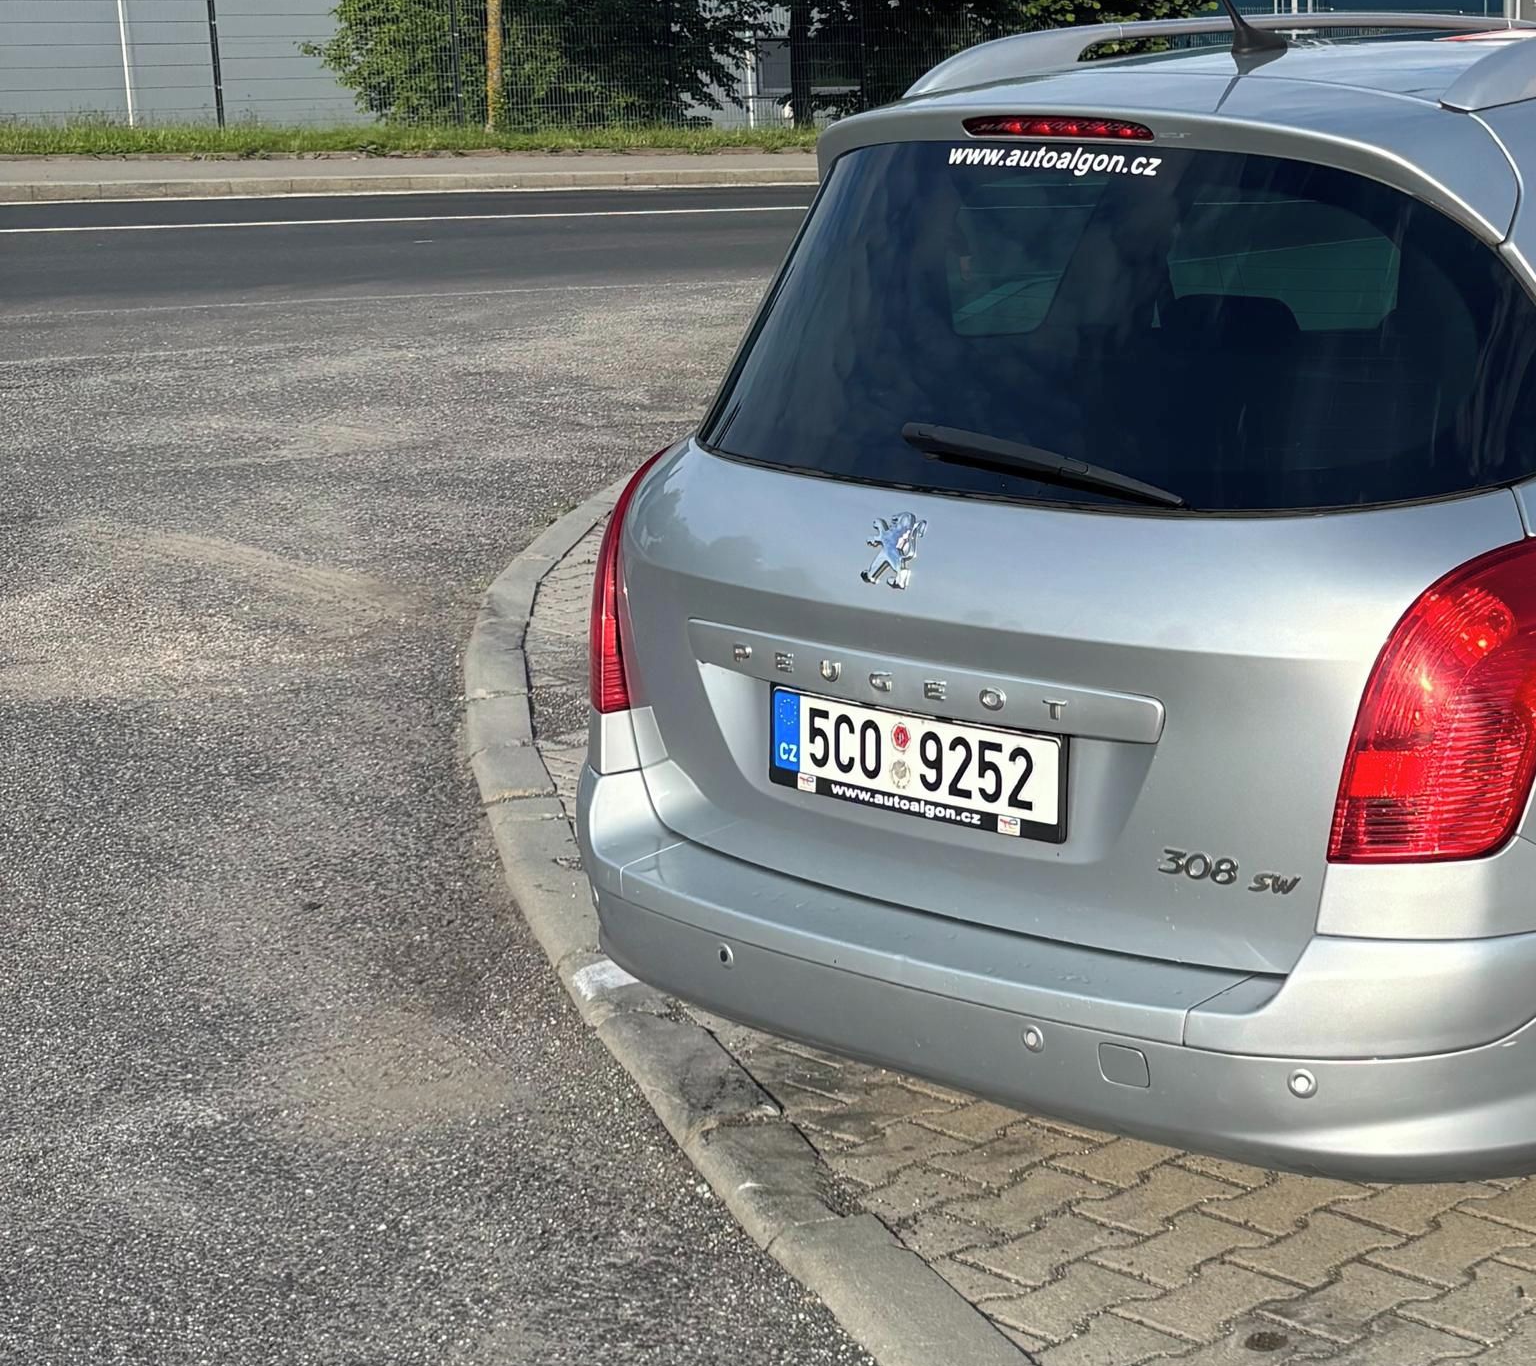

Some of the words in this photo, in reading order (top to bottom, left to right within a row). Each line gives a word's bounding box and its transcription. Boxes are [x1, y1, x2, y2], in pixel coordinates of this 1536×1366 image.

[948, 146, 1163, 177] www.autoalgon.cz
[732, 643, 1067, 721] PEUGEOT
[779, 741, 798, 763] CZ
[919, 731, 1034, 812] 9252
[831, 782, 982, 826] www.autoalgon.cz
[1157, 848, 1239, 886] 308
[1248, 873, 1301, 895] SW
